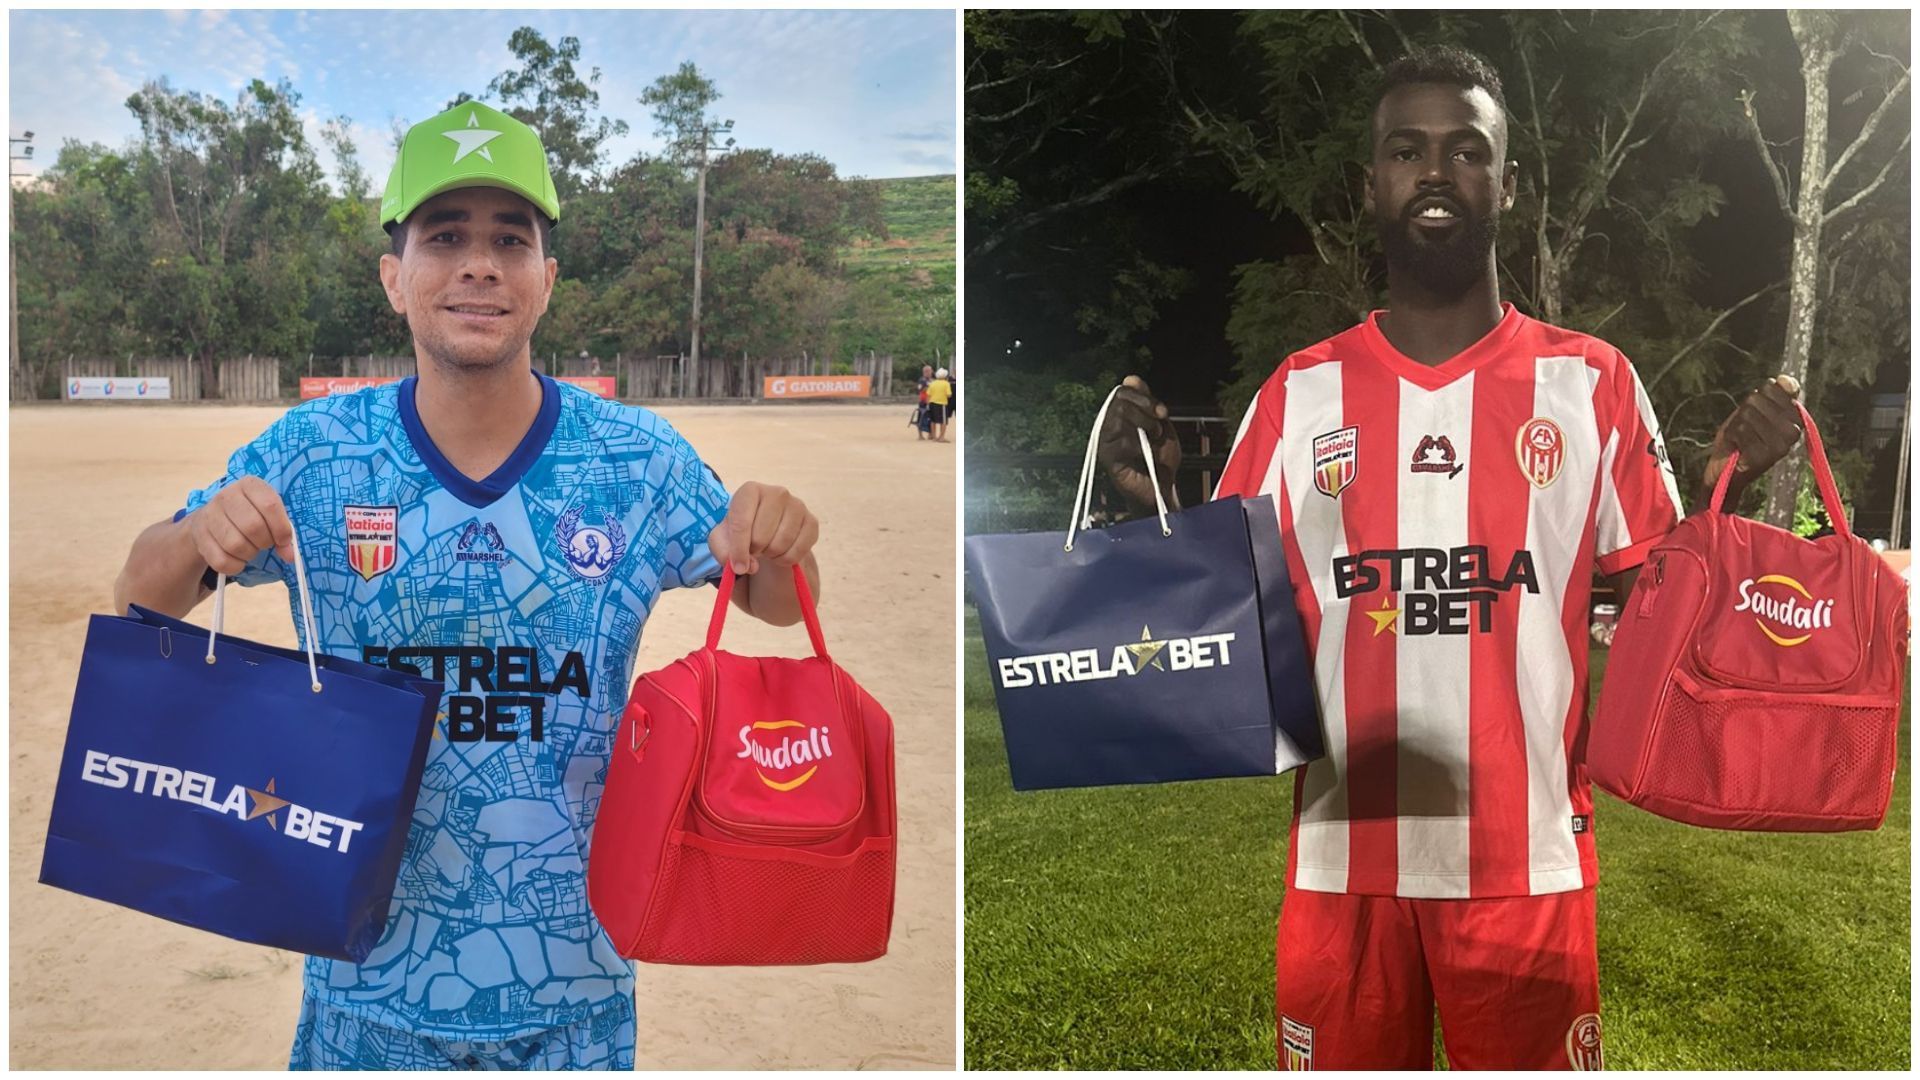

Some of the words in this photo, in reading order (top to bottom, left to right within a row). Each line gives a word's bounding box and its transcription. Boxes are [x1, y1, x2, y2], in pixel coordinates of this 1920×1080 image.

[327, 381, 376, 394] Saud
[791, 381, 862, 392] GATORADE
[1333, 545, 1540, 599] ESTRELA
[1404, 591, 1498, 636] BET
[1734, 578, 1834, 629] Saudali
[998, 645, 1138, 688] ESTRELA
[1168, 632, 1235, 671] BET
[449, 696, 546, 742] BET
[737, 725, 832, 769] Saudali
[81, 749, 248, 822] ESTRELA
[284, 803, 364, 853] BET
